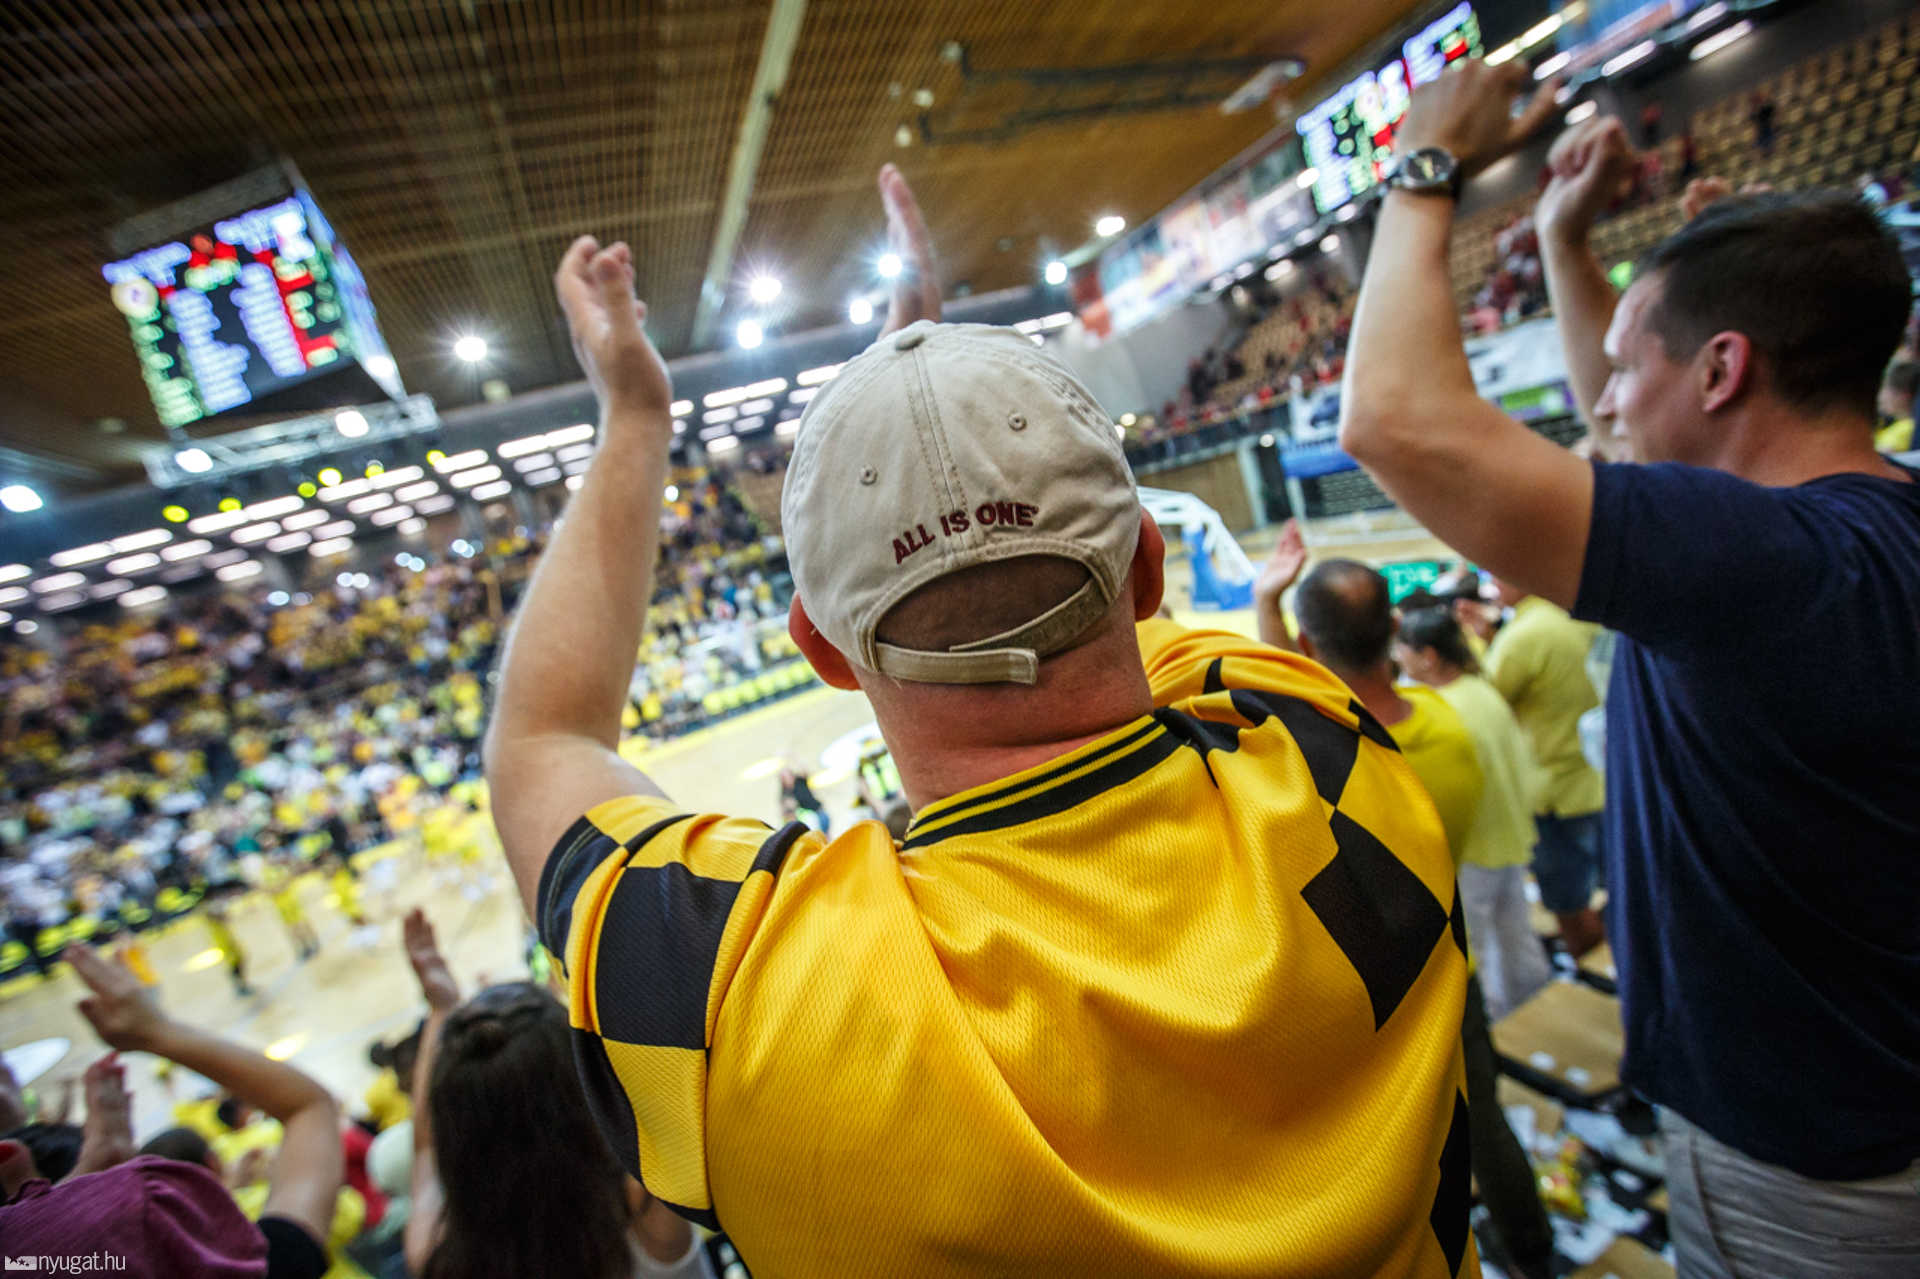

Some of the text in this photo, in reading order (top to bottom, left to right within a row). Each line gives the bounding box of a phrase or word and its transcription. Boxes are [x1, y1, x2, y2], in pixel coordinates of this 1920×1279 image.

[892, 501, 1039, 564] ALL IS ONE
